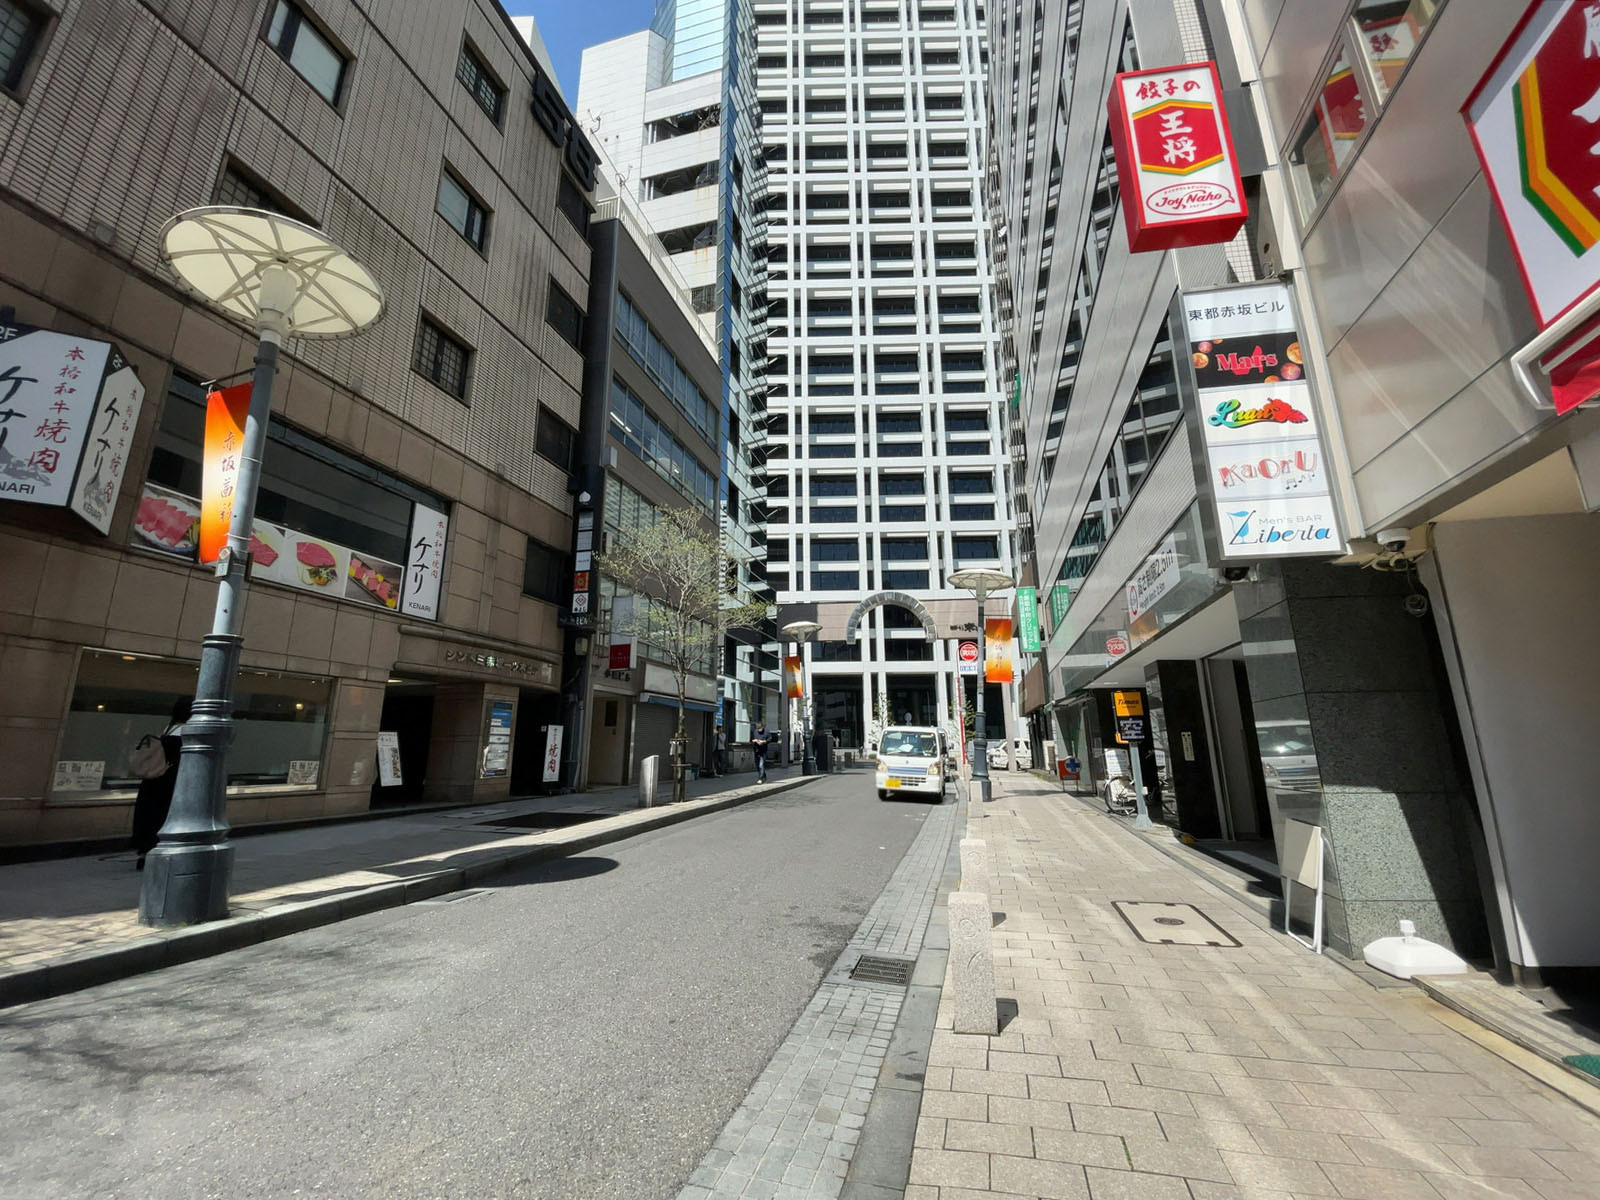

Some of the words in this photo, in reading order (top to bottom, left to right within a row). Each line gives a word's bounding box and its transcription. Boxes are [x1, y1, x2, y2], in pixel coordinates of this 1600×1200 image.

[1136, 78, 1200, 100] 餃子の
[1160, 110, 1197, 165] 王将
[1155, 197, 1184, 210] Joy
[1185, 190, 1222, 203] Naho
[1188, 300, 1286, 321] 東都赤坂ビル
[1215, 347, 1279, 374] Mars
[28, 346, 86, 475] 本格和牛焼肉
[91, 398, 120, 485] ケナリ
[1258, 515, 1293, 525] Men's
[1296, 513, 1322, 523] BAR
[411, 536, 433, 596] ケナリ
[408, 601, 432, 613] KENARI
